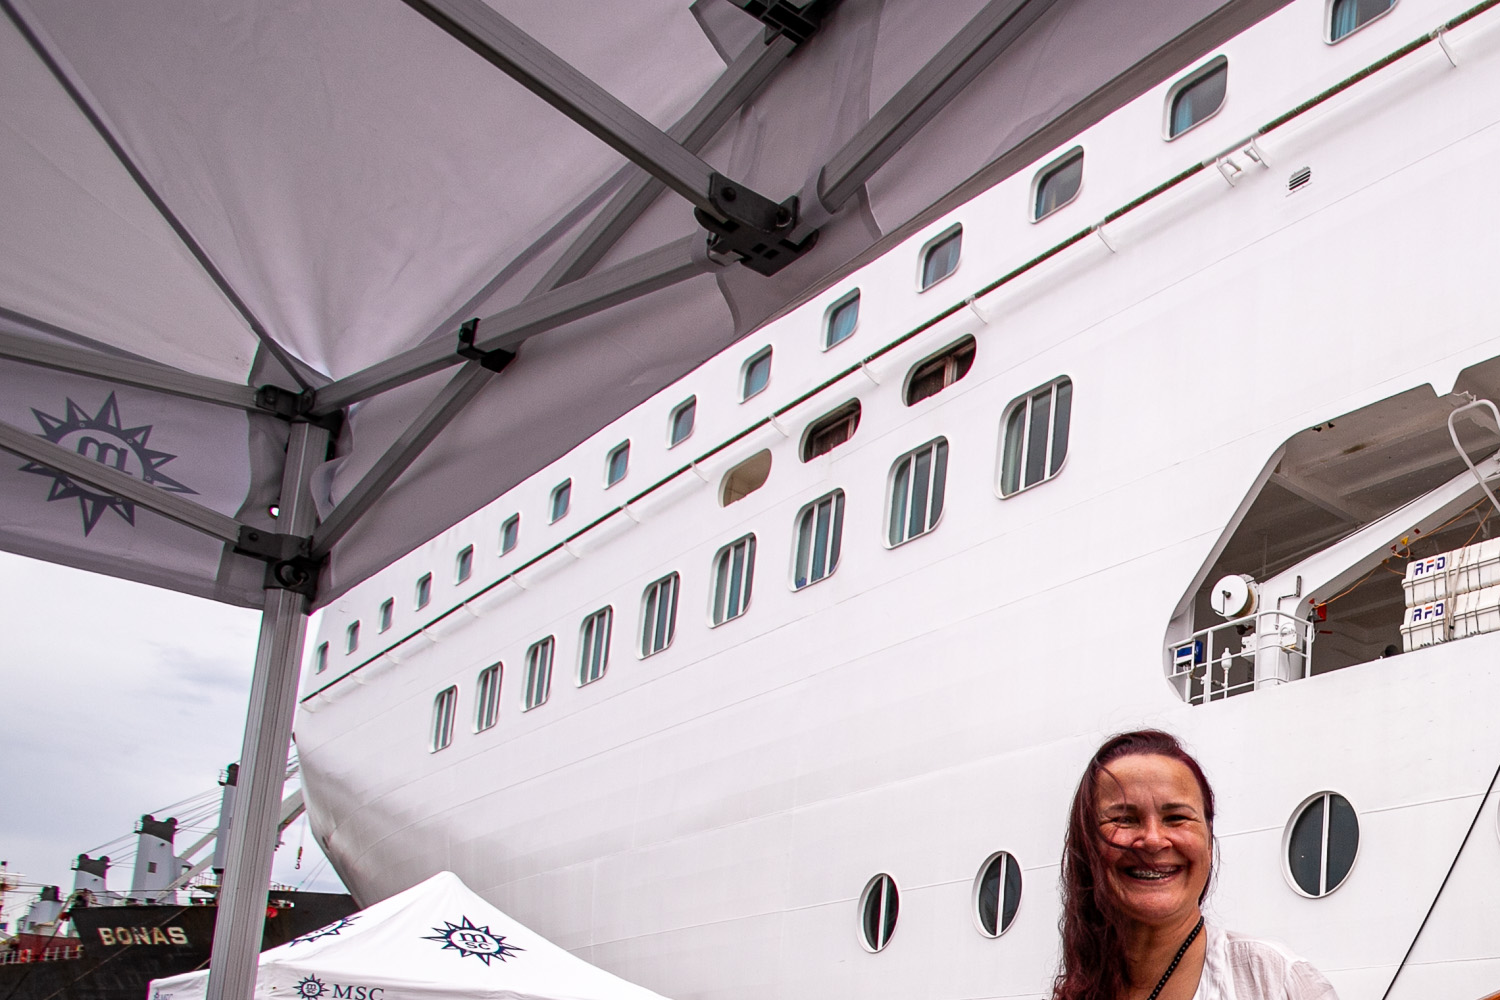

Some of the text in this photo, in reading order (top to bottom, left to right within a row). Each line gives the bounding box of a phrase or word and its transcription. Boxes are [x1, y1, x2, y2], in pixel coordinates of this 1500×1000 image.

[1415, 556, 1446, 576] RFD
[1413, 602, 1444, 622] RFD
[97, 926, 189, 946] BONAS
